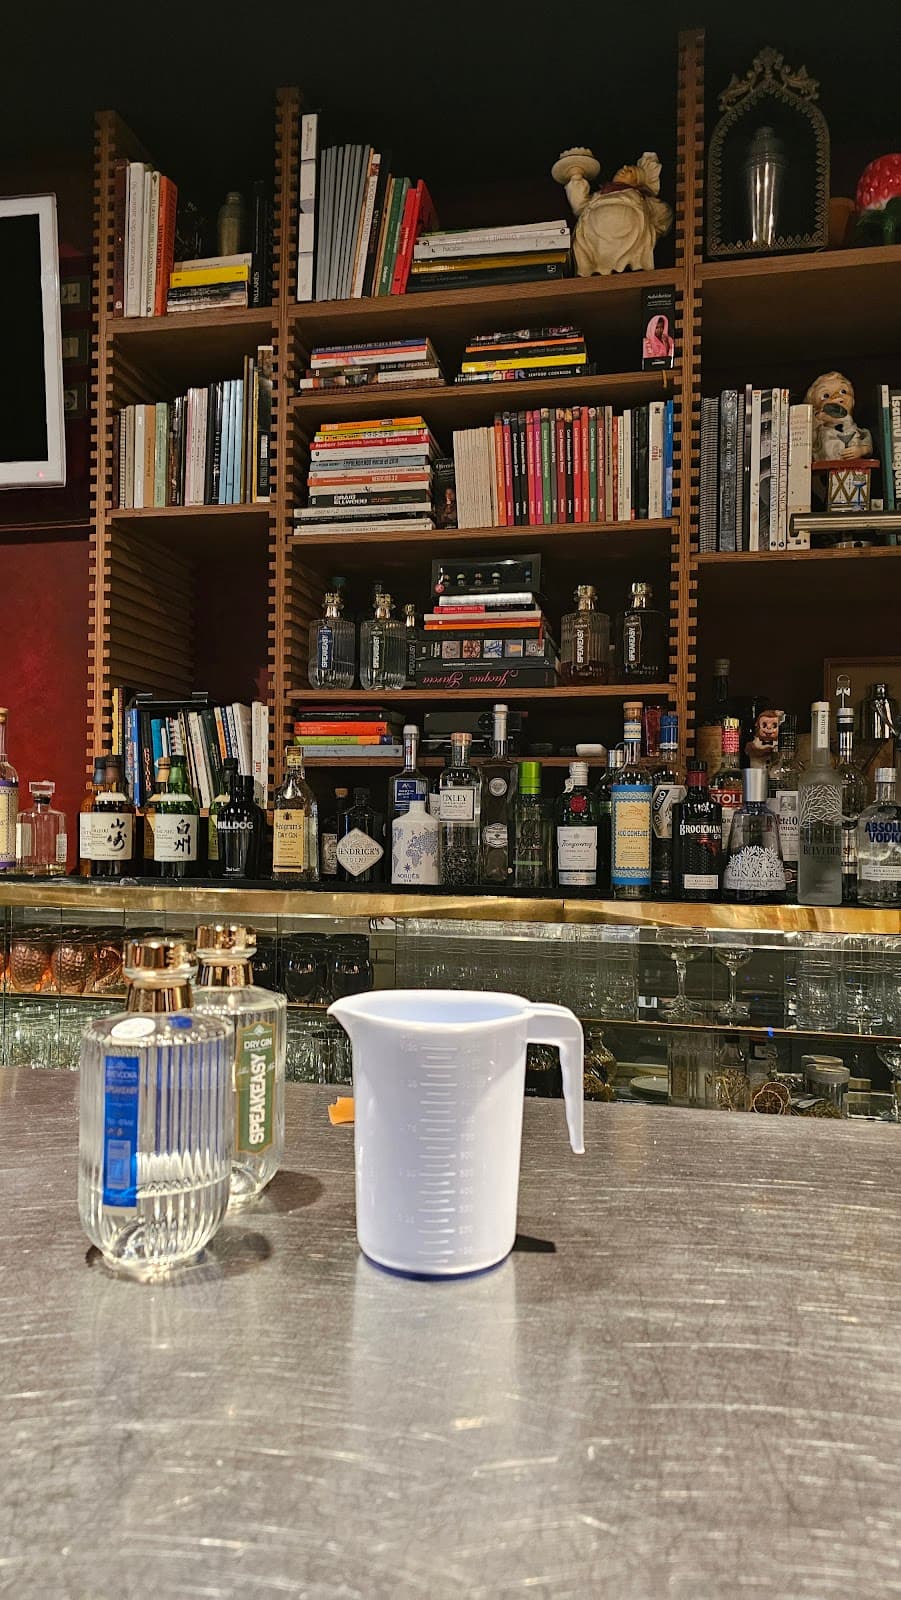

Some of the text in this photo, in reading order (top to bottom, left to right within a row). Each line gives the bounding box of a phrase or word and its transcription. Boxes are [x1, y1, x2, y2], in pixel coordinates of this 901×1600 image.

[422, 669, 518, 688] Jacques Garcia
[174, 818, 192, 855] 白州
[244, 1037, 273, 1050] DRY GIN
[248, 1053, 267, 1145] SPEAKEASY
